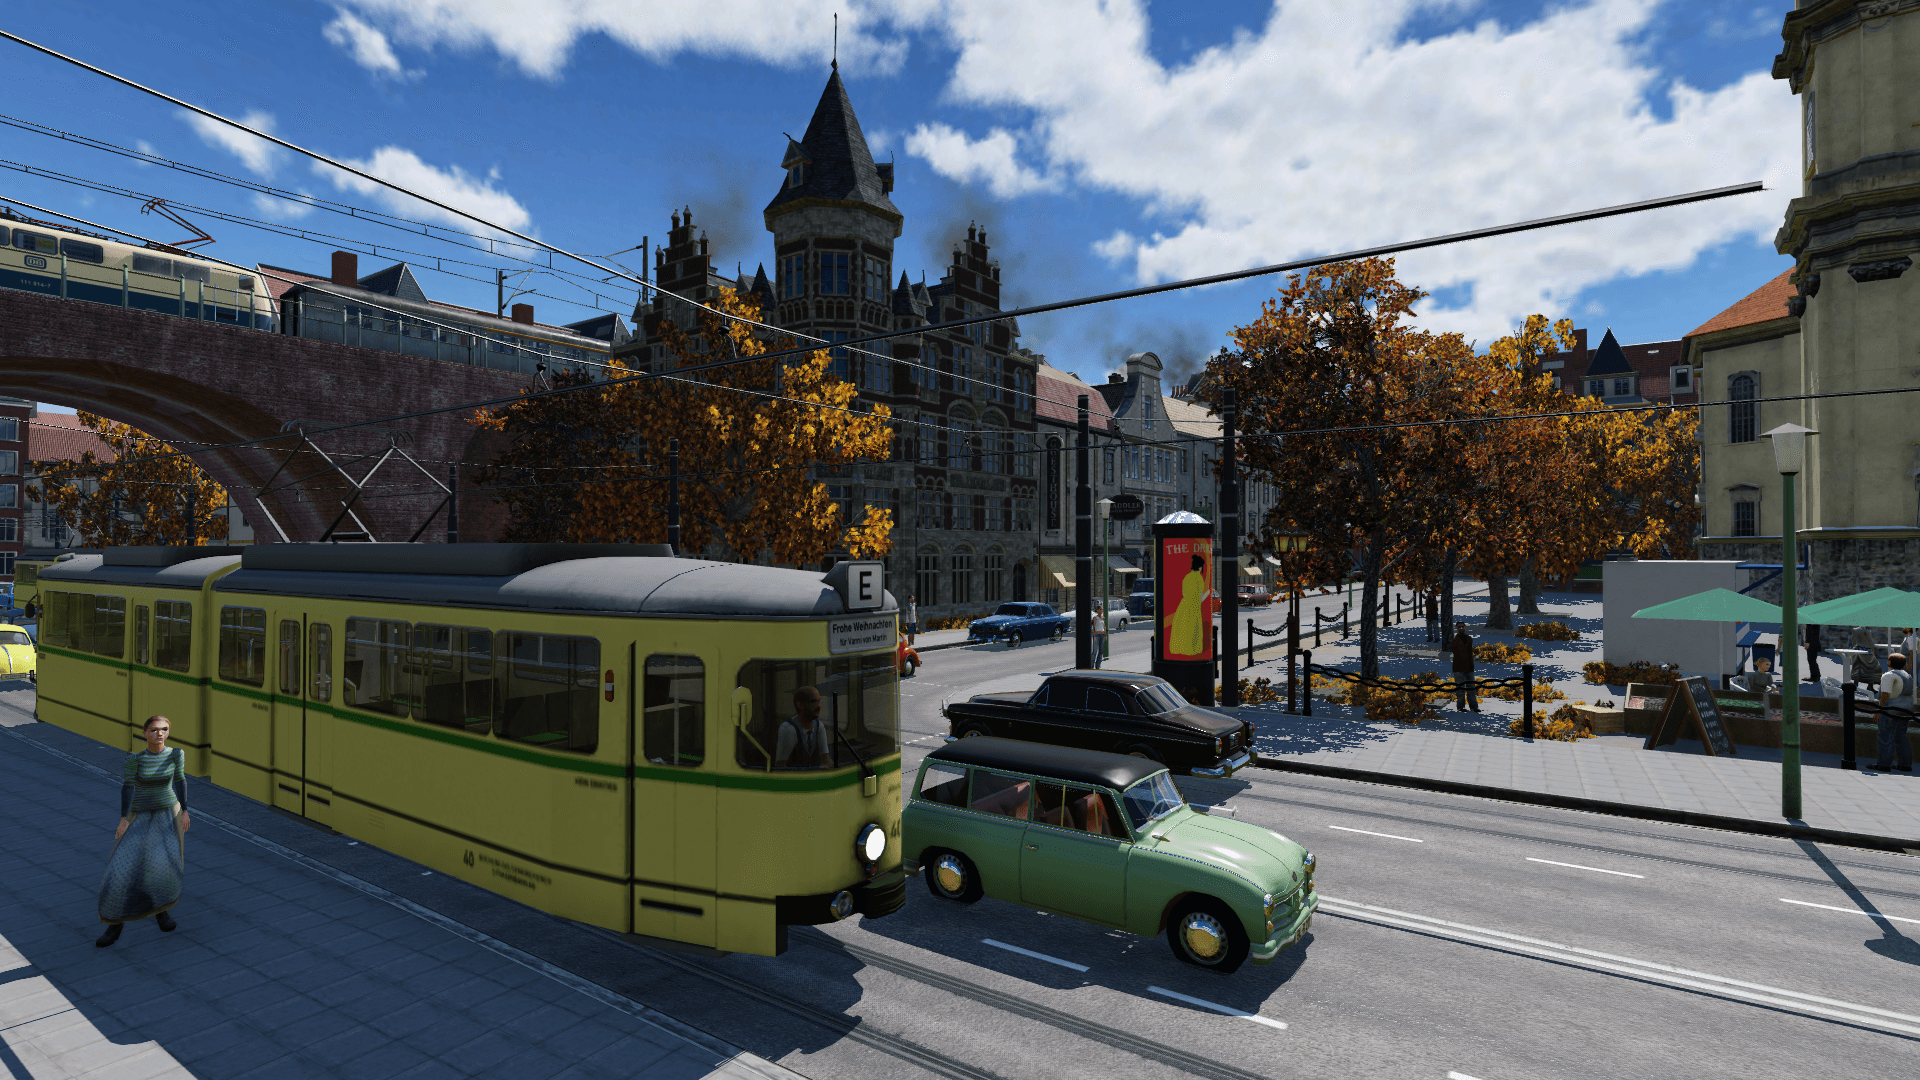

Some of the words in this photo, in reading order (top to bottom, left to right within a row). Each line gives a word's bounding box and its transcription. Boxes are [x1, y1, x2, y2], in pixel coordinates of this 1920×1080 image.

[1049, 439, 1058, 527] GUESTHOUSE
[1166, 543, 1189, 555] THE
[860, 571, 872, 600] E
[832, 623, 852, 634] Frohe
[853, 620, 893, 631] Weihnachten
[872, 634, 888, 642] Martin
[463, 849, 475, 869] 40
